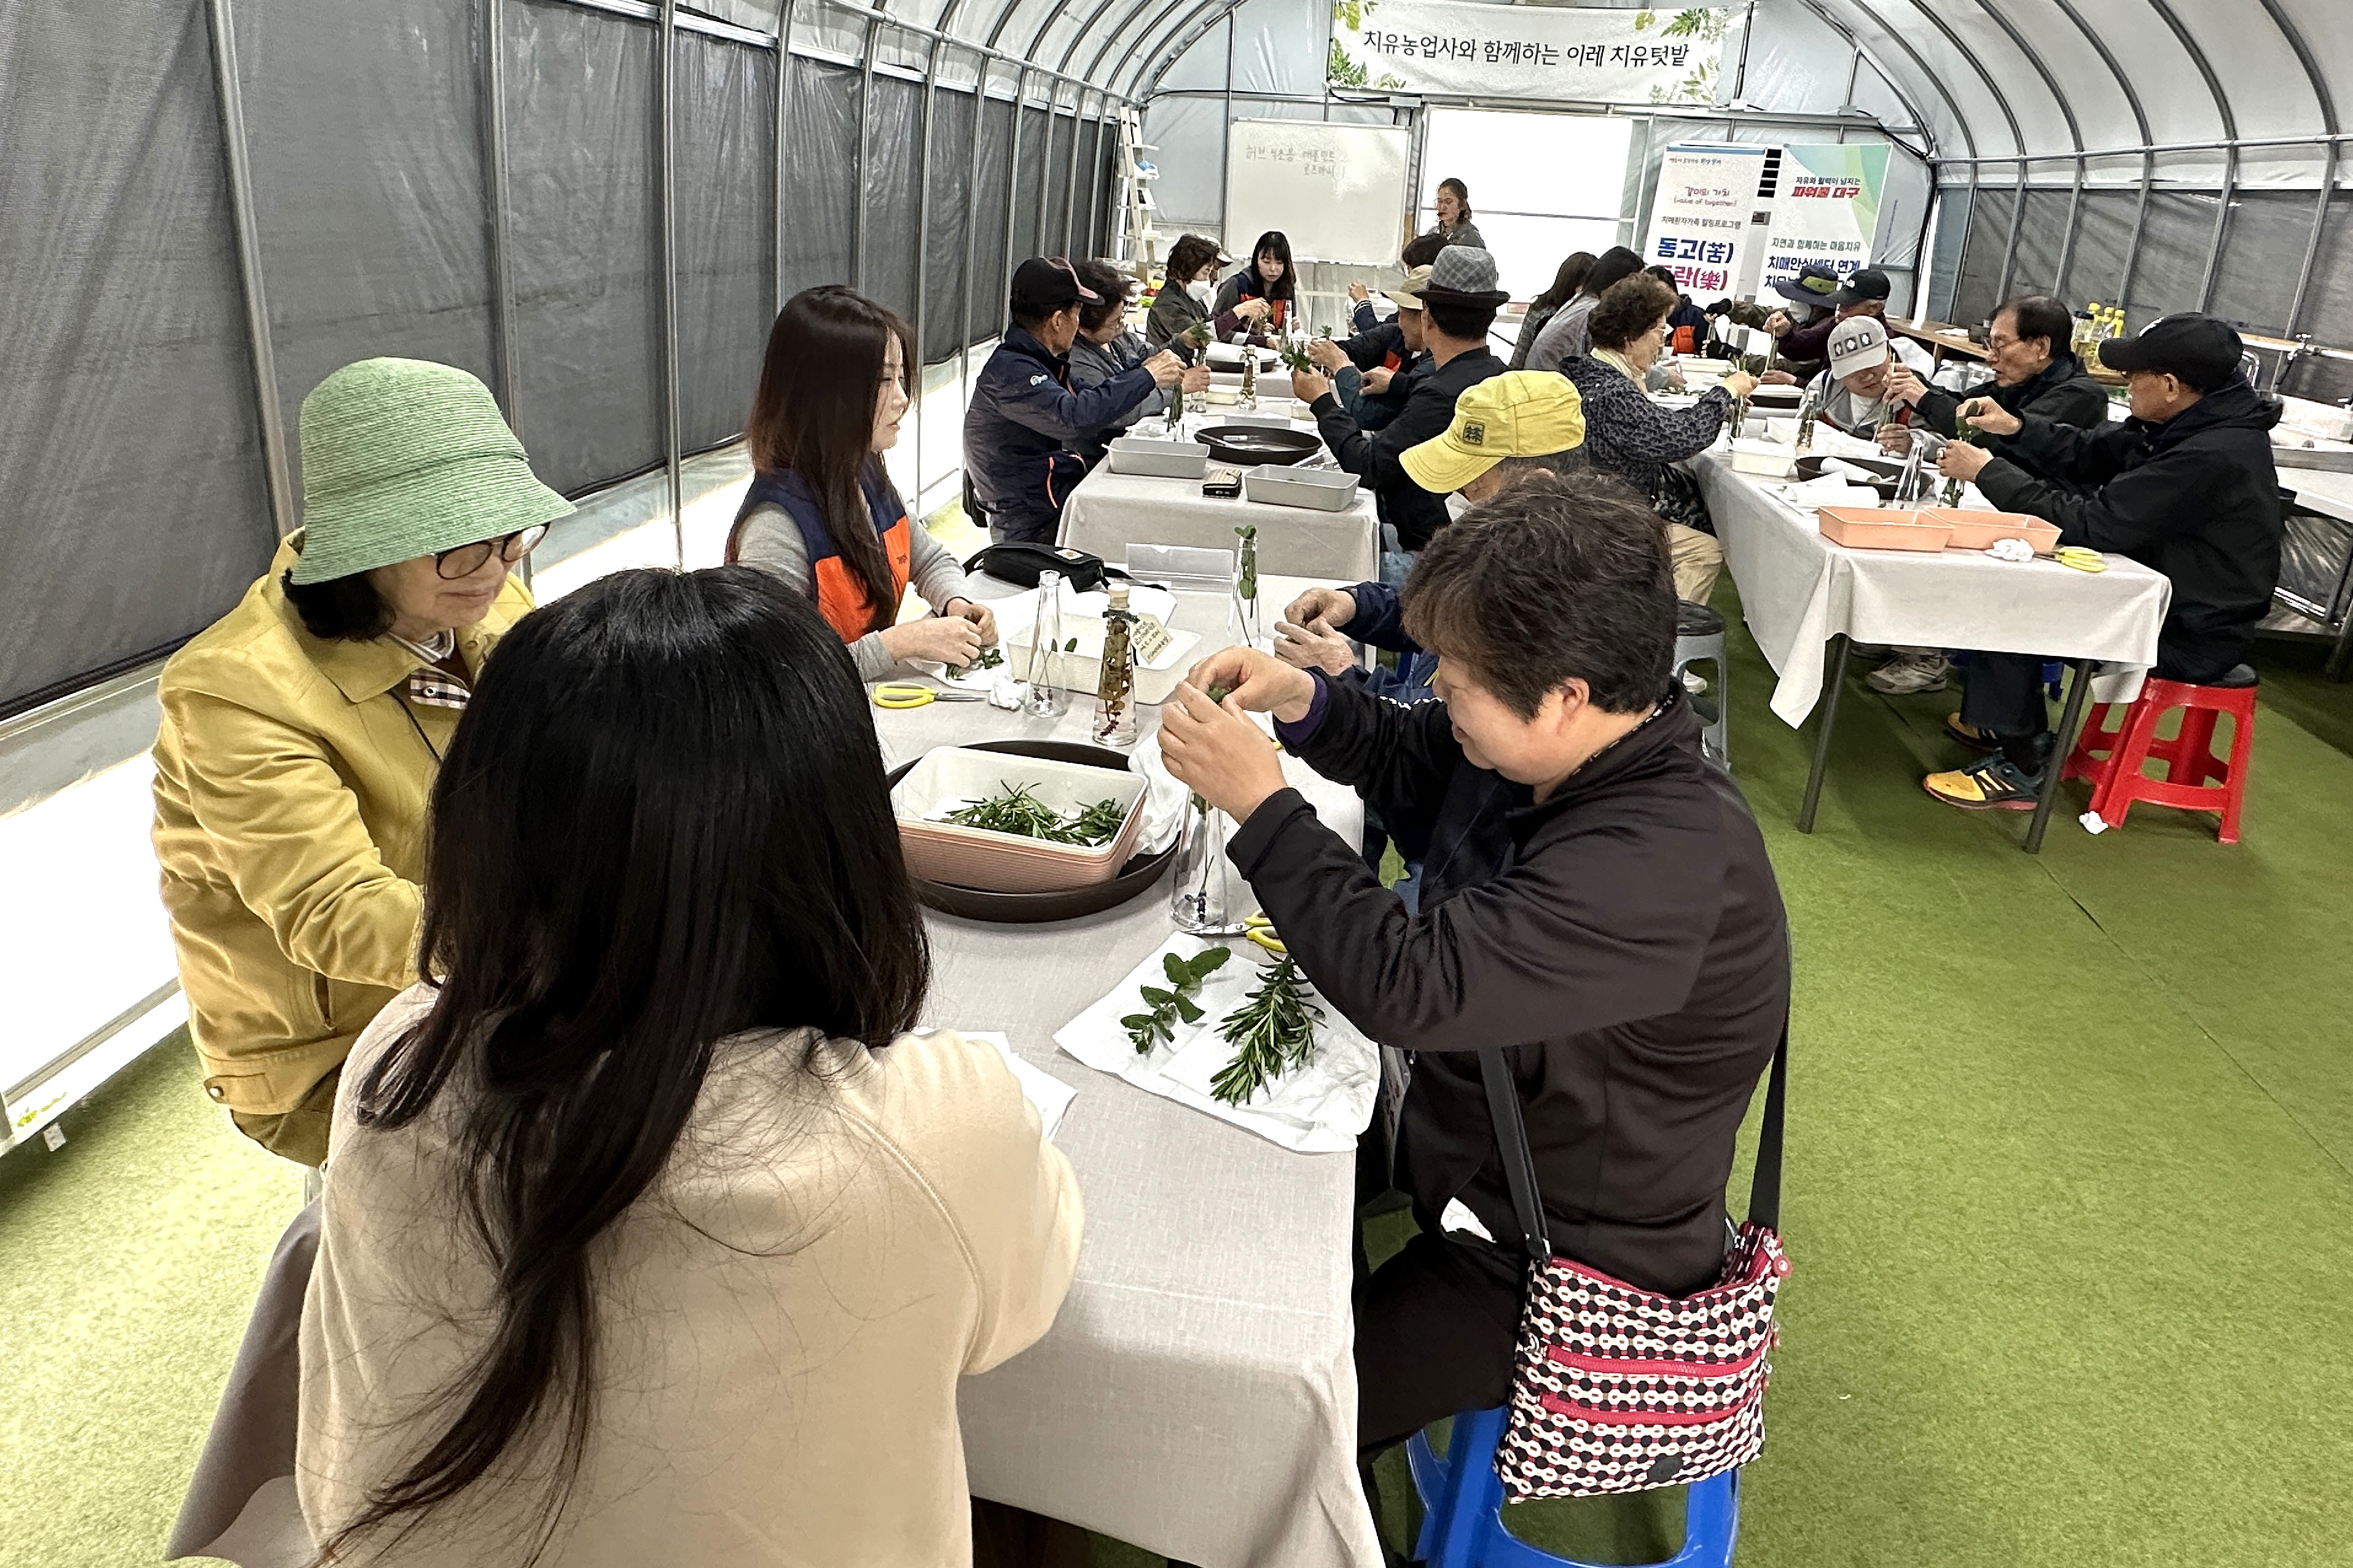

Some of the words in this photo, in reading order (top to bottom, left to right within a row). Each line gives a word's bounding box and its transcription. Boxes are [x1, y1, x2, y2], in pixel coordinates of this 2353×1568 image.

[1363, 31, 1477, 61] 치유농업사와
[1484, 40, 1560, 66] 함께하는
[1567, 44, 1605, 68] 이레
[1610, 44, 1689, 68] 치유텃밭
[1246, 144, 1267, 160] 허브
[1796, 176, 1817, 185] 자유와
[1831, 187, 1860, 198] 대구
[1658, 237, 1734, 263] 동고(苦)
[1771, 237, 1795, 248] 자연과
[1796, 239, 1828, 251] 함께하는
[1830, 241, 1862, 252] 마음치유
[1838, 260, 1861, 273] 연계
[1656, 264, 1728, 291] 락(樂)
